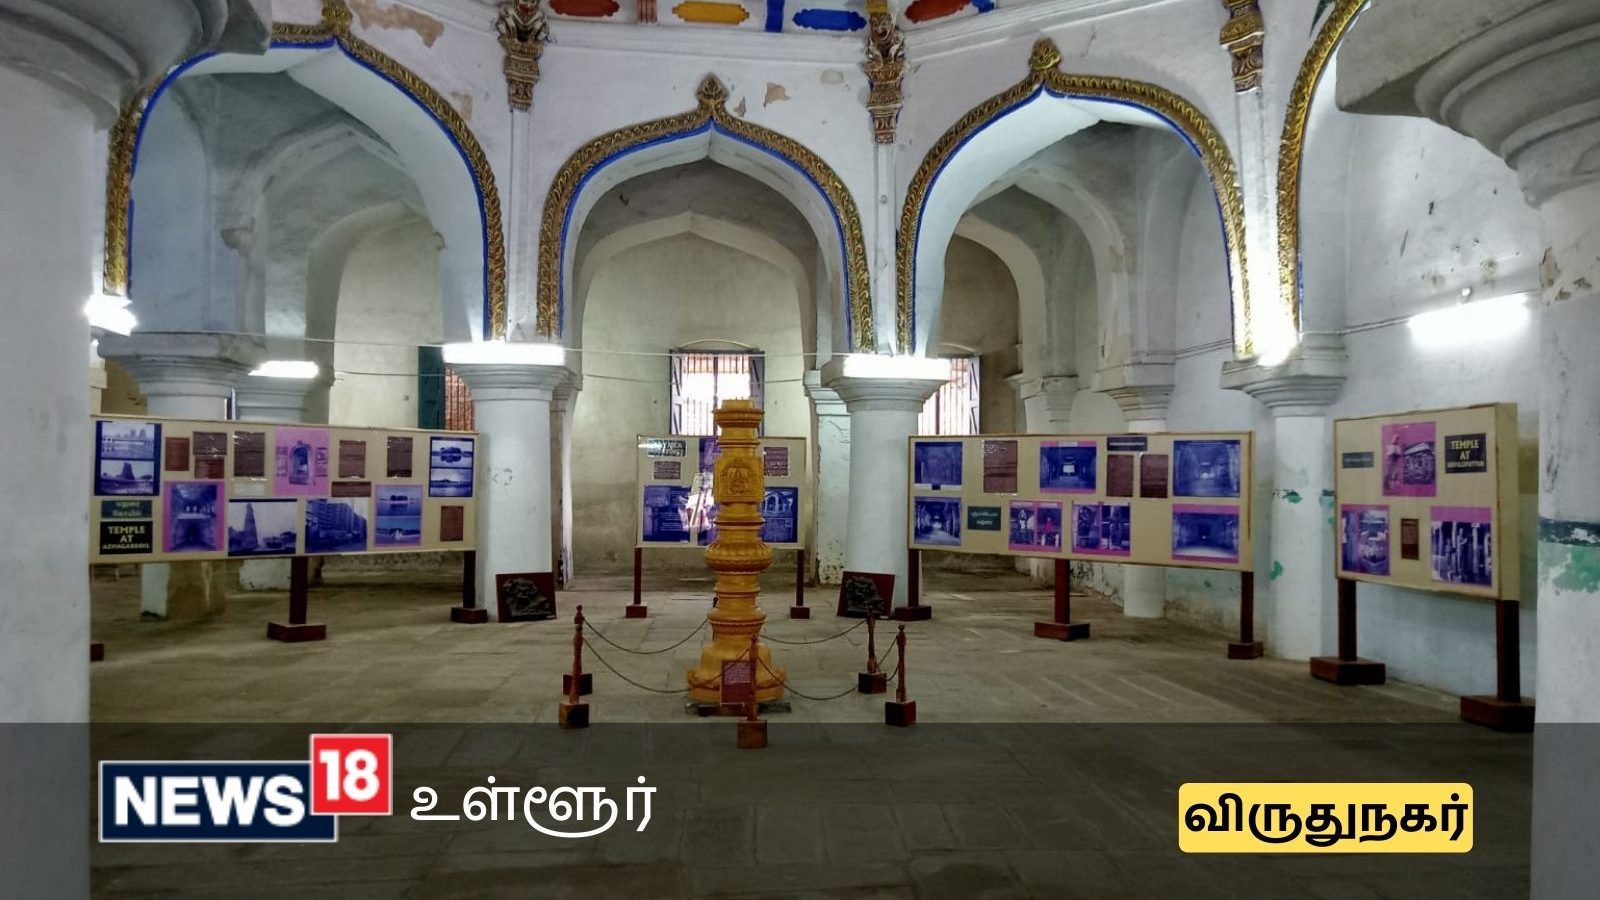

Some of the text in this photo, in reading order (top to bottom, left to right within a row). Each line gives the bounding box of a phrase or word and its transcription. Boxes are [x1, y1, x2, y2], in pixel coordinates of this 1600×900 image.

[1450, 439, 1480, 450] TEMPLE
[1459, 450, 1471, 461] AT
[107, 525, 146, 535] TEMPLE
[119, 534, 134, 544] AT
